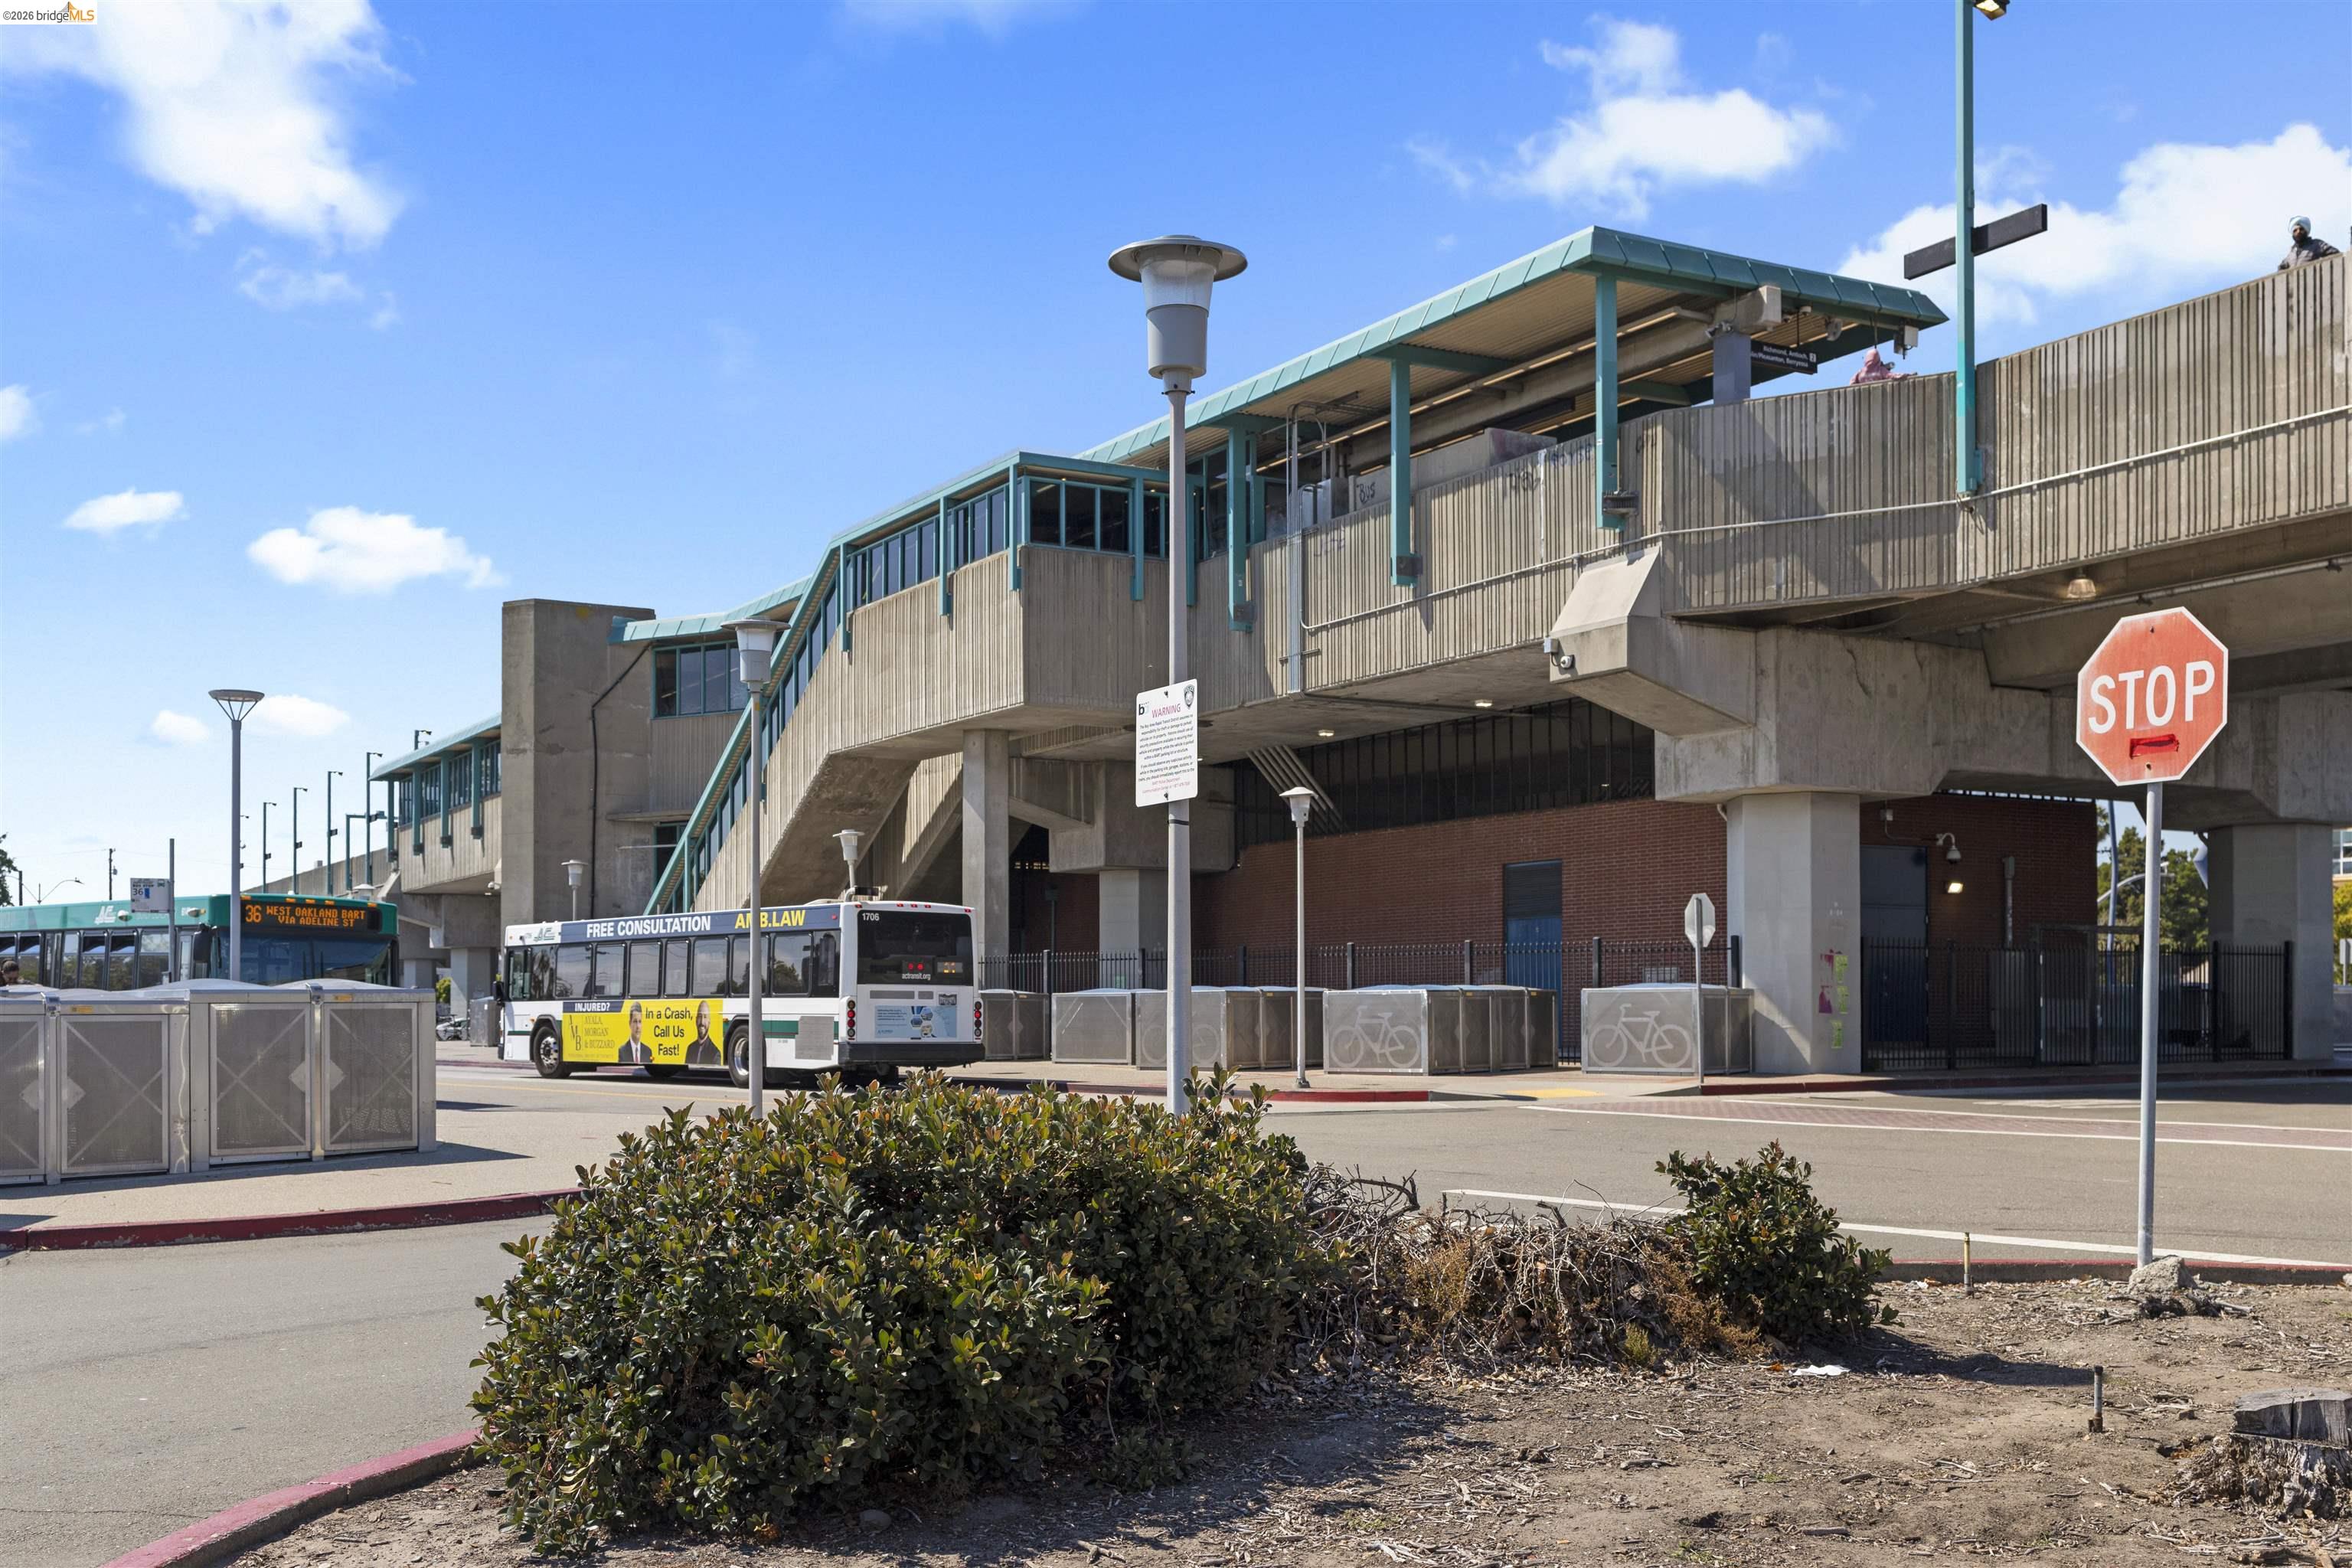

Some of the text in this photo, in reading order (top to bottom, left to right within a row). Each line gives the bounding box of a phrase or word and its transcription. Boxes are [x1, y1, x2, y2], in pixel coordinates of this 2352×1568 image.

[2089, 660, 2215, 734] STOP
[1152, 704, 1181, 718] WARNING
[245, 905, 365, 923] 36 WEST OAKLAND BART
[862, 913, 880, 921] 1706
[278, 915, 355, 927] VIA ADELINE ST
[586, 916, 711, 938] FREE CONSULTATION
[575, 1001, 610, 1012] INJURED?
[645, 1008, 693, 1021] In a Crash,
[584, 1027, 609, 1037] MORGAN
[654, 1025, 684, 1038] Call Us
[584, 1040, 615, 1049] & BUZZARD
[658, 1044, 680, 1056] Fast!
